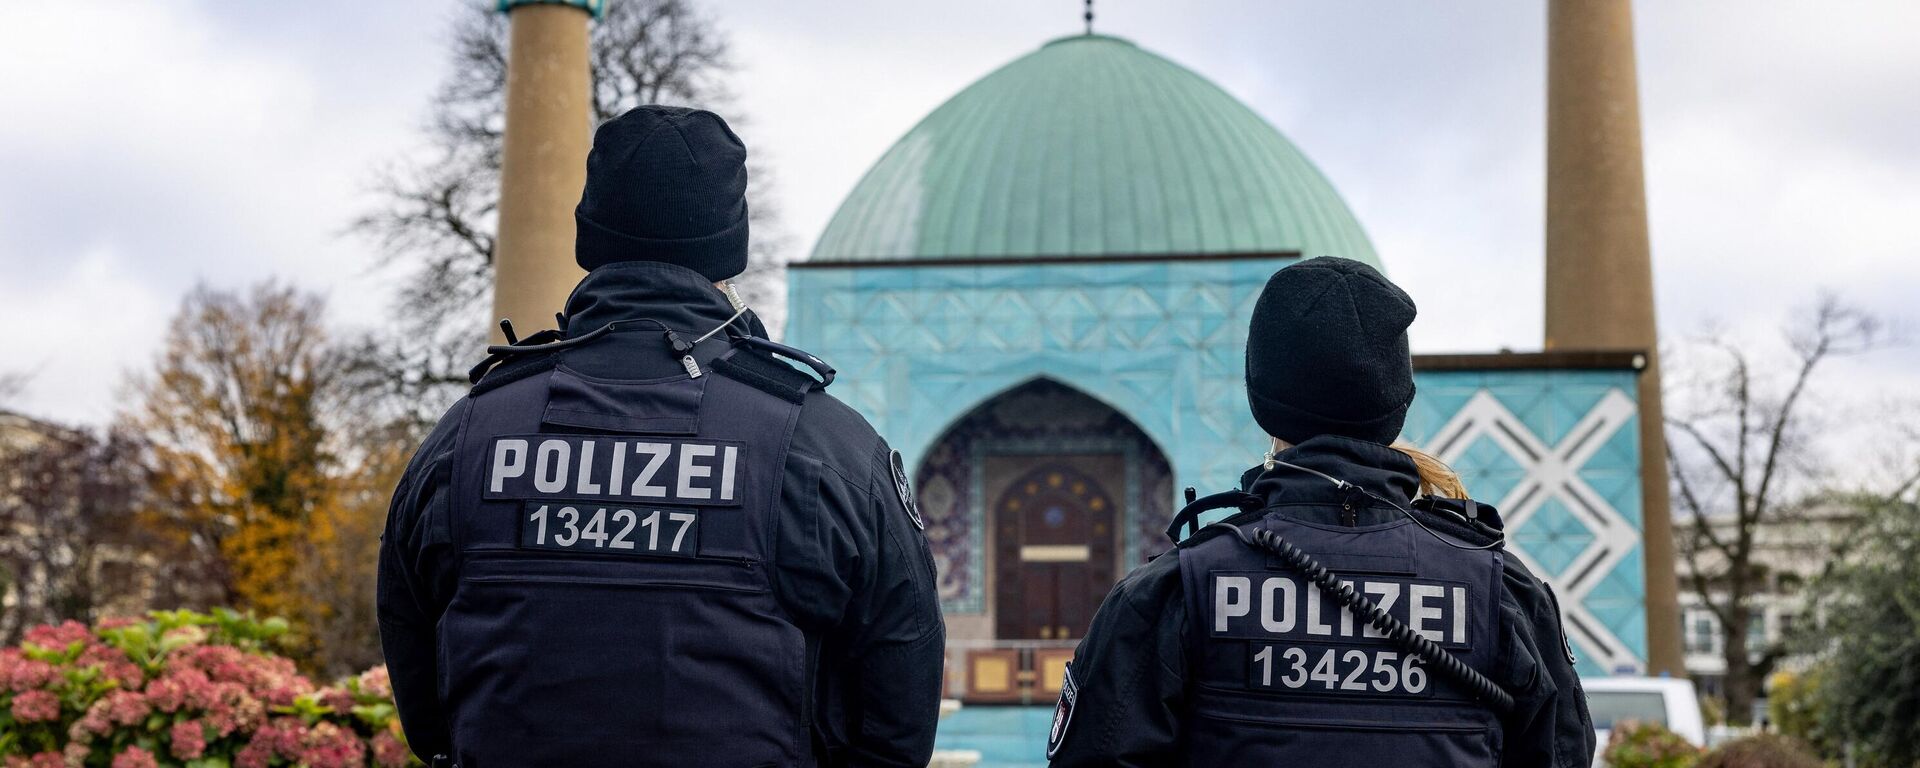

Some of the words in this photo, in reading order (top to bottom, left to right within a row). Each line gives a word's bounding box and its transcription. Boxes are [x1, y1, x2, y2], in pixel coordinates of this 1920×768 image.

[490, 439, 738, 501] POLIZEI
[530, 505, 696, 552] 134217
[1215, 575, 1466, 644] POLIZEI
[1254, 645, 1428, 694] 134256
